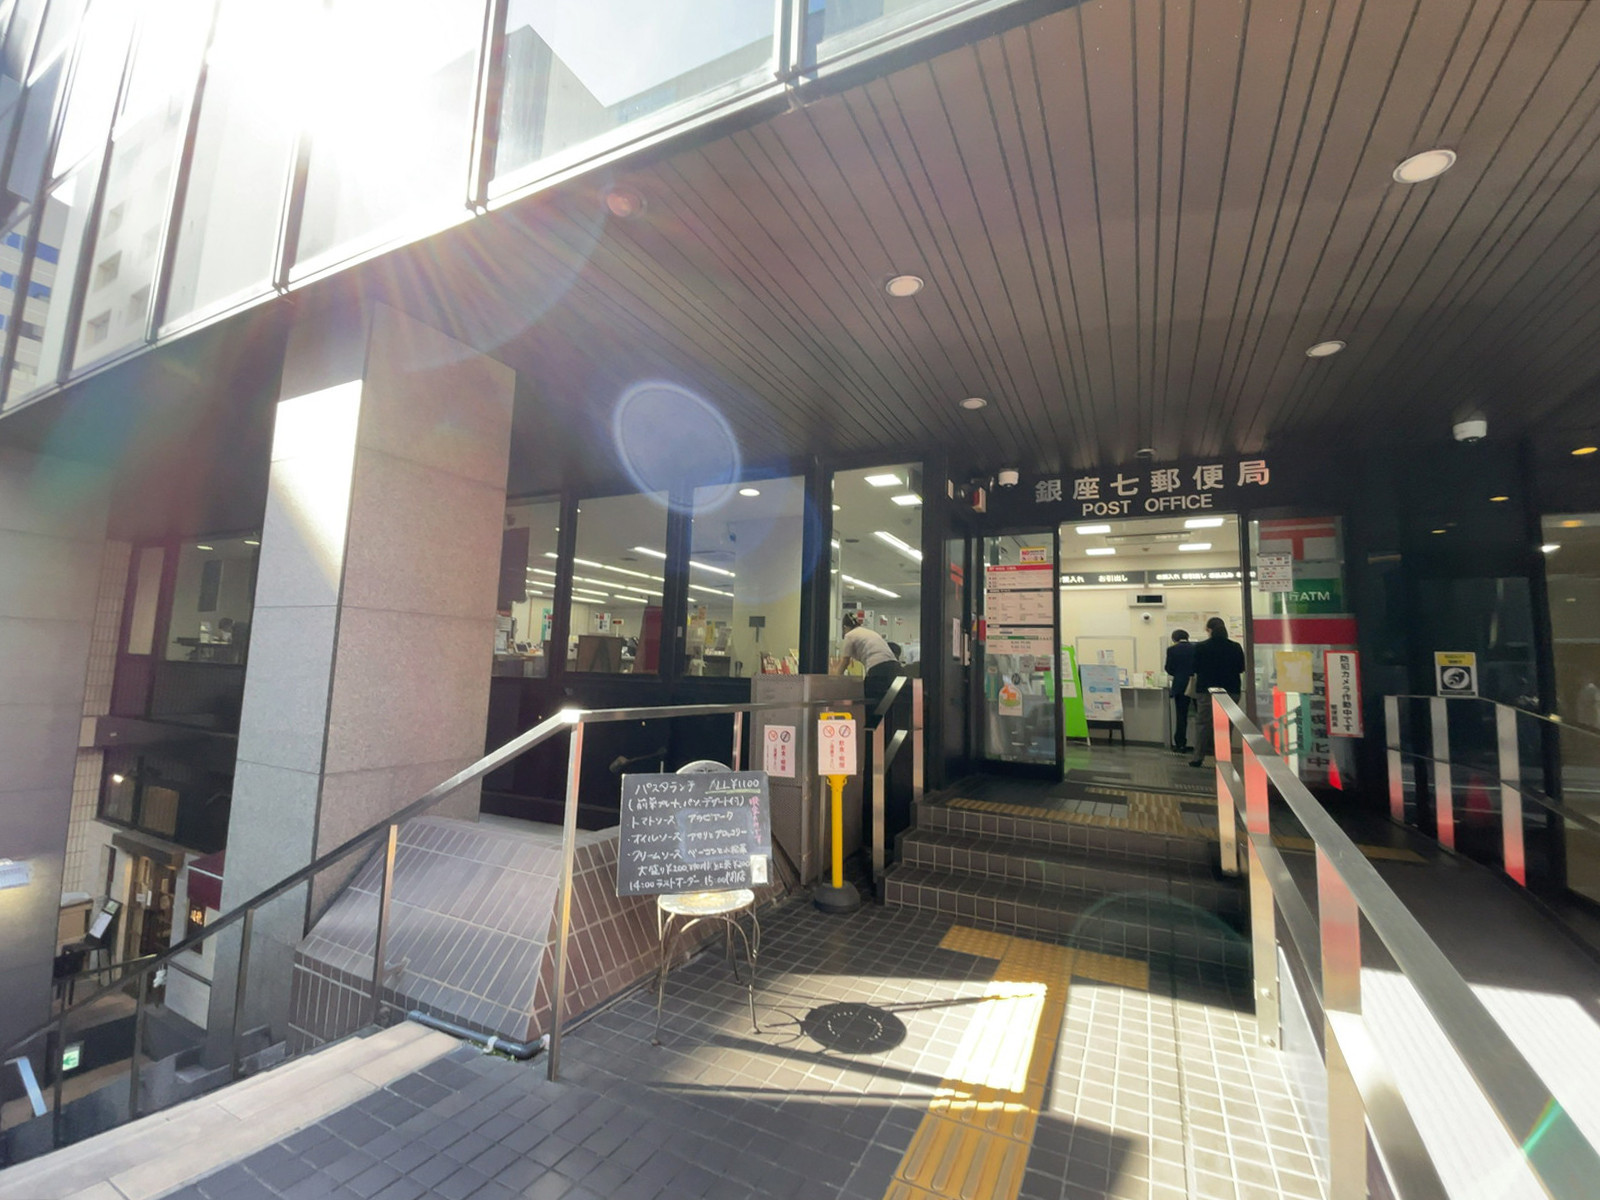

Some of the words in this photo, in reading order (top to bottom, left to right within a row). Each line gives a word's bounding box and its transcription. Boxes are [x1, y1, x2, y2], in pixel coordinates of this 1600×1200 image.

[1035, 459, 1270, 503] 銀座七郵便局
[1082, 500, 1131, 517] POST
[1144, 493, 1213, 513] OFFICE
[1340, 654, 1354, 732] 防犯カメラ作動中です
